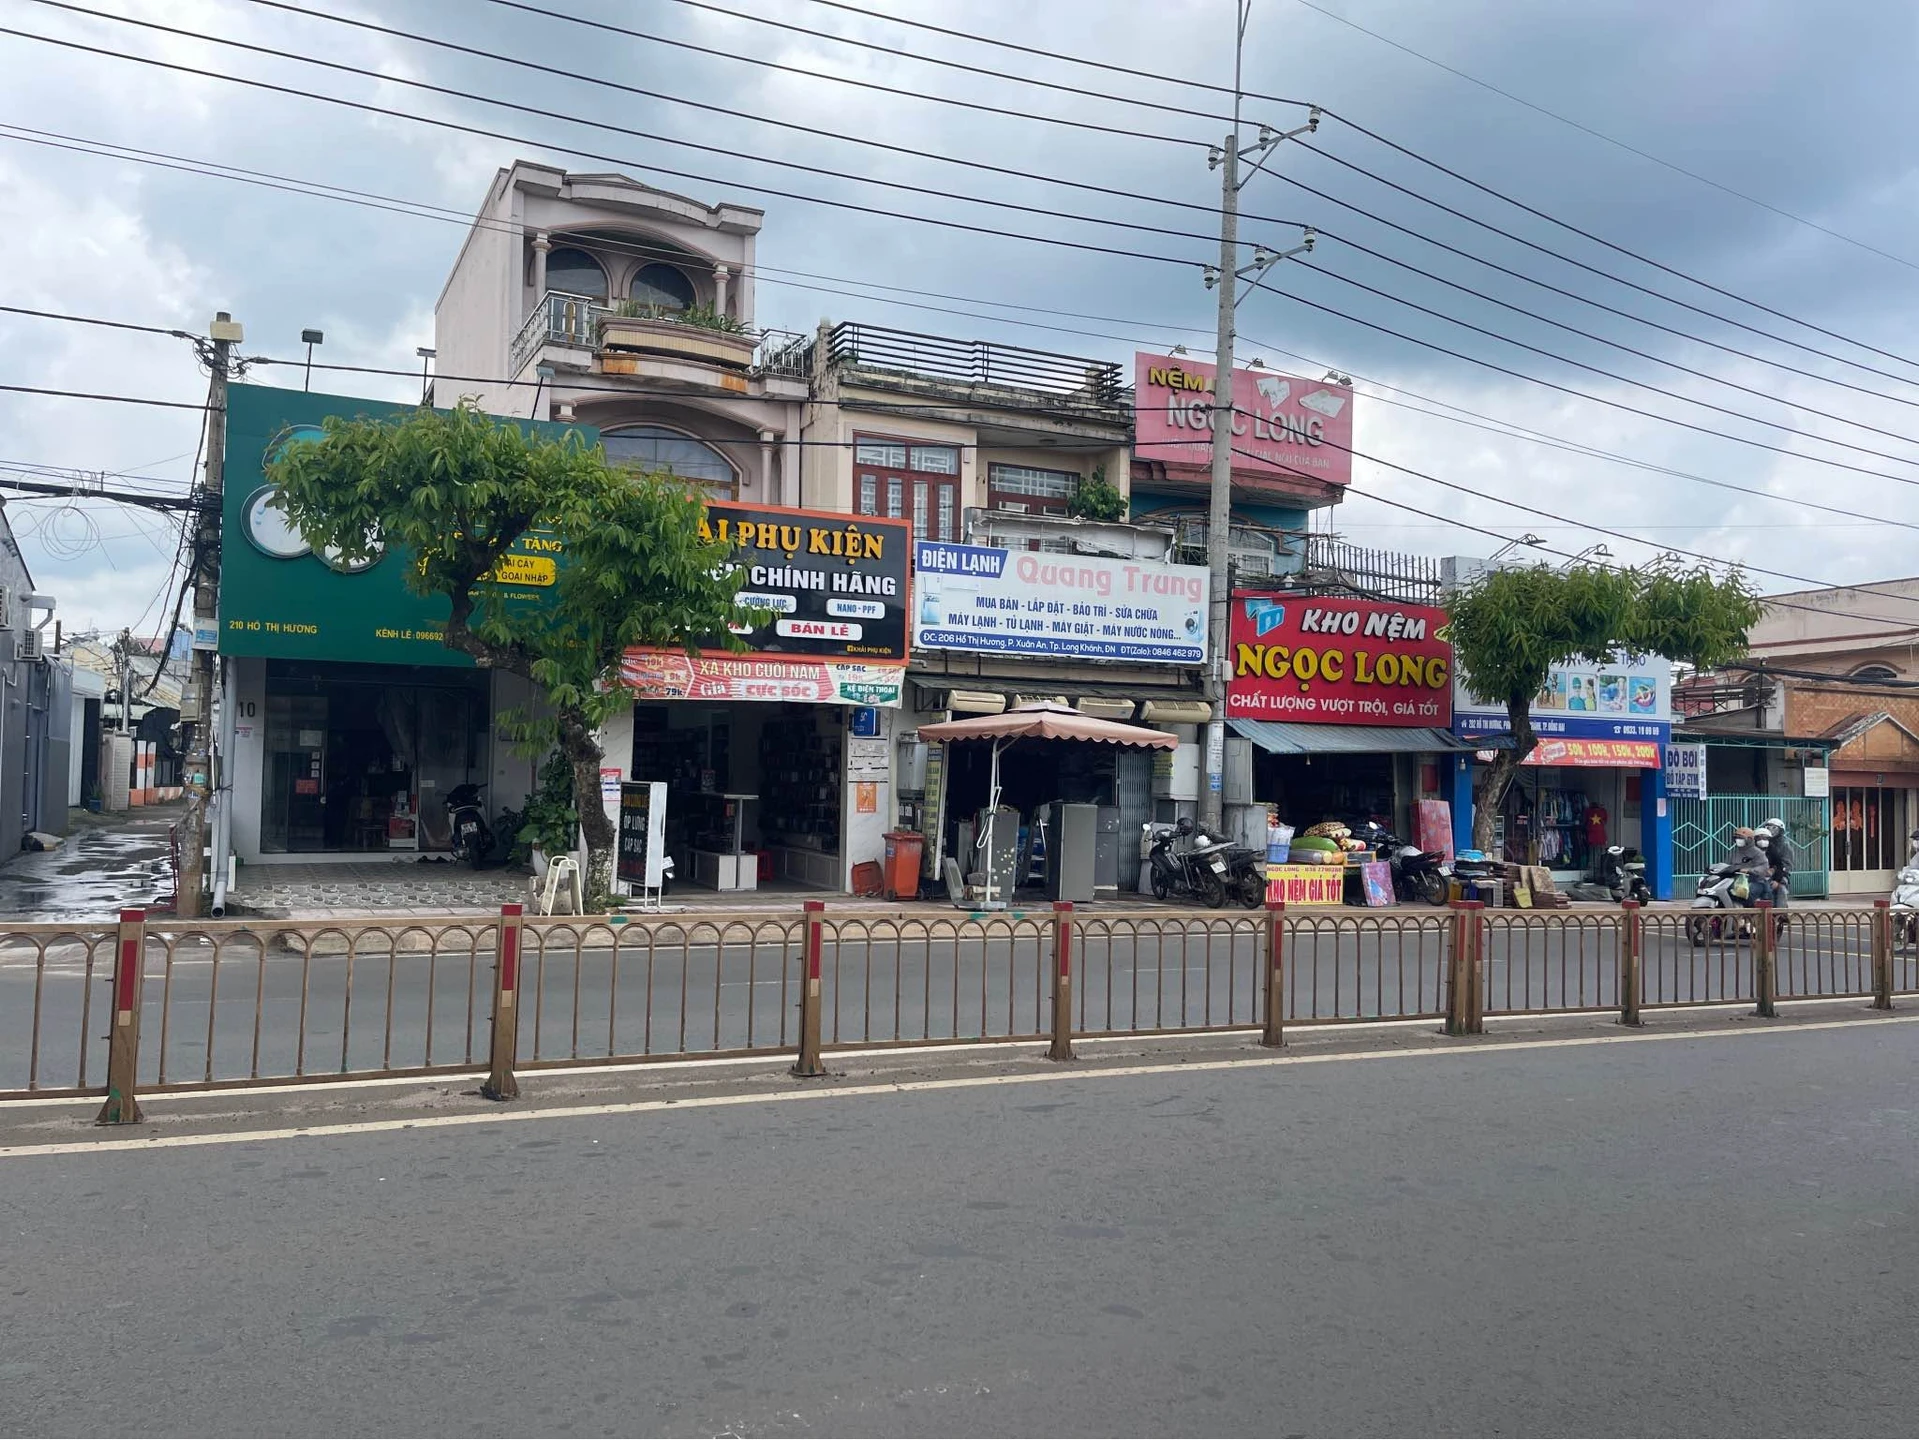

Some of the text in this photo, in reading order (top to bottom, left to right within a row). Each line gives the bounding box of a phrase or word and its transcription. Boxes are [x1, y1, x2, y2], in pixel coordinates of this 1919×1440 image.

[1149, 365, 1203, 394] NỆM
[1255, 408, 1324, 447] LONG
[738, 521, 801, 559] PHỤ
[809, 524, 884, 565] KIỆN
[922, 547, 1000, 575] ĐIỆN LẠNH
[751, 565, 825, 590] CHÍNH
[833, 571, 896, 596] HÃNG
[1016, 556, 1202, 602] Quang Trung
[836, 603, 857, 613] NANO
[862, 604, 876, 614] PPF
[976, 596, 997, 609] MUA
[1000, 596, 1018, 610] BÁN
[1027, 597, 1045, 612] LẮP
[1047, 600, 1064, 616] ĐẶT
[1073, 601, 1090, 616] BẢO
[1093, 604, 1106, 617] TRÌ
[1115, 604, 1132, 619] SỬA
[1135, 607, 1158, 621] CHỮA
[229, 620, 244, 631] 210
[265, 622, 280, 633] THỊ
[283, 623, 318, 634] HƯƠNG
[415, 631, 444, 641] 096692
[791, 623, 849, 636] BÁN LẺ
[948, 612, 969, 625] MÁY
[972, 615, 997, 629] LẠNH
[1006, 615, 1017, 629] TỦ
[1019, 619, 1043, 633] LẠNH
[1052, 620, 1072, 633] MÁY
[1074, 622, 1094, 637] GIẶT
[1103, 623, 1122, 637] MÁY
[1124, 625, 1148, 638] NƯỚC
[1302, 608, 1426, 642] KHO NỆM
[938, 634, 954, 643] 206
[968, 635, 979, 647] Thị
[1016, 639, 1035, 648] Xuân
[1062, 643, 1079, 654] Long
[1105, 645, 1116, 653] ĐN
[1152, 647, 1172, 656] 0846
[1172, 648, 1187, 657] 462
[1187, 649, 1201, 658] 979
[700, 659, 719, 675] XẢ
[724, 661, 751, 676] KHO
[756, 662, 785, 678] CUỐI
[1236, 643, 1448, 692] NGỌC LONG
[700, 681, 811, 697] Giá CỰC SỐC
[1230, 691, 1439, 716] CHẤT LƯỢNG VƯỢT TRỘI, GIÁ TỐT
[1667, 748, 1680, 767] ĐỒ
[1683, 749, 1697, 768] BƠI
[1267, 873, 1342, 904] KHO NỆM GIÁ TỐT
